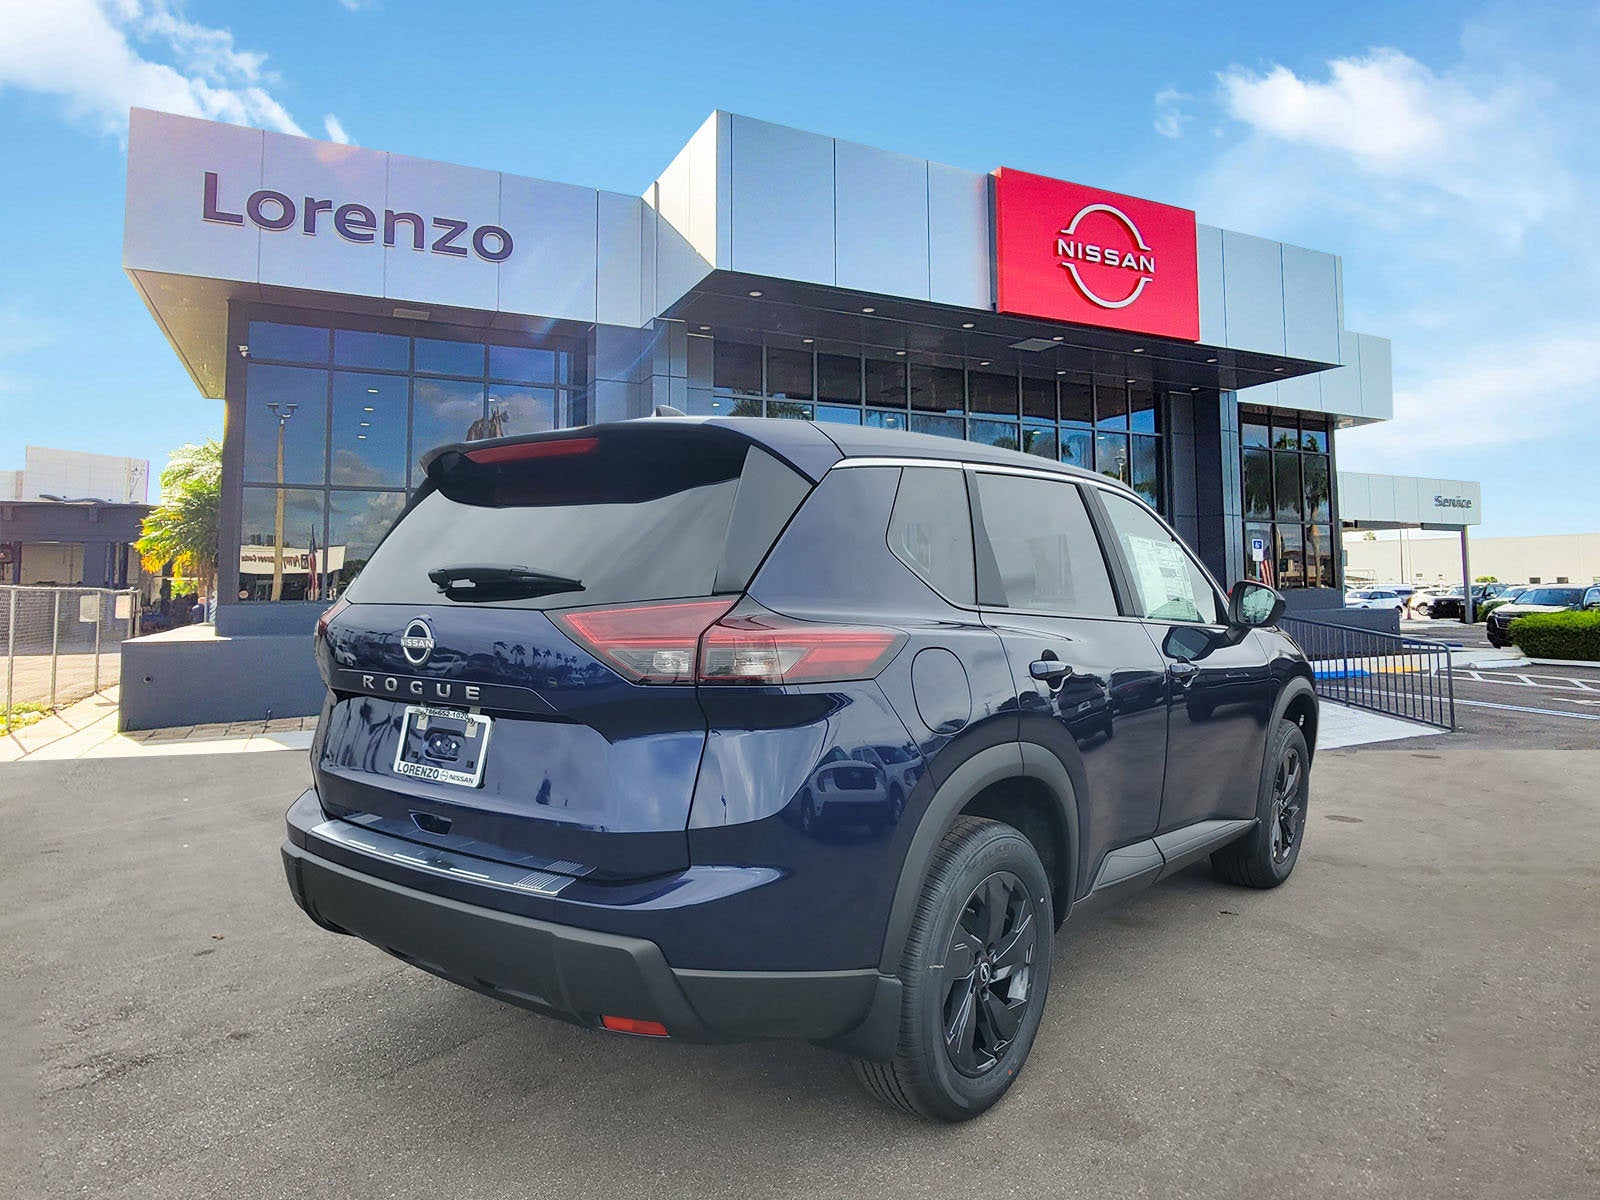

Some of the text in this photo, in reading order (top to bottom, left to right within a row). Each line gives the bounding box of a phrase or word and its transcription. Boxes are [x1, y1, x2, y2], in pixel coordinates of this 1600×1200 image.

[202, 171, 514, 262] Lorenzo
[1058, 238, 1155, 273] NISSAN
[1434, 495, 1472, 509] Service
[401, 637, 434, 649] NISSAN
[362, 674, 480, 700] ROGUE
[397, 762, 474, 784] LORENZO NISSAN
